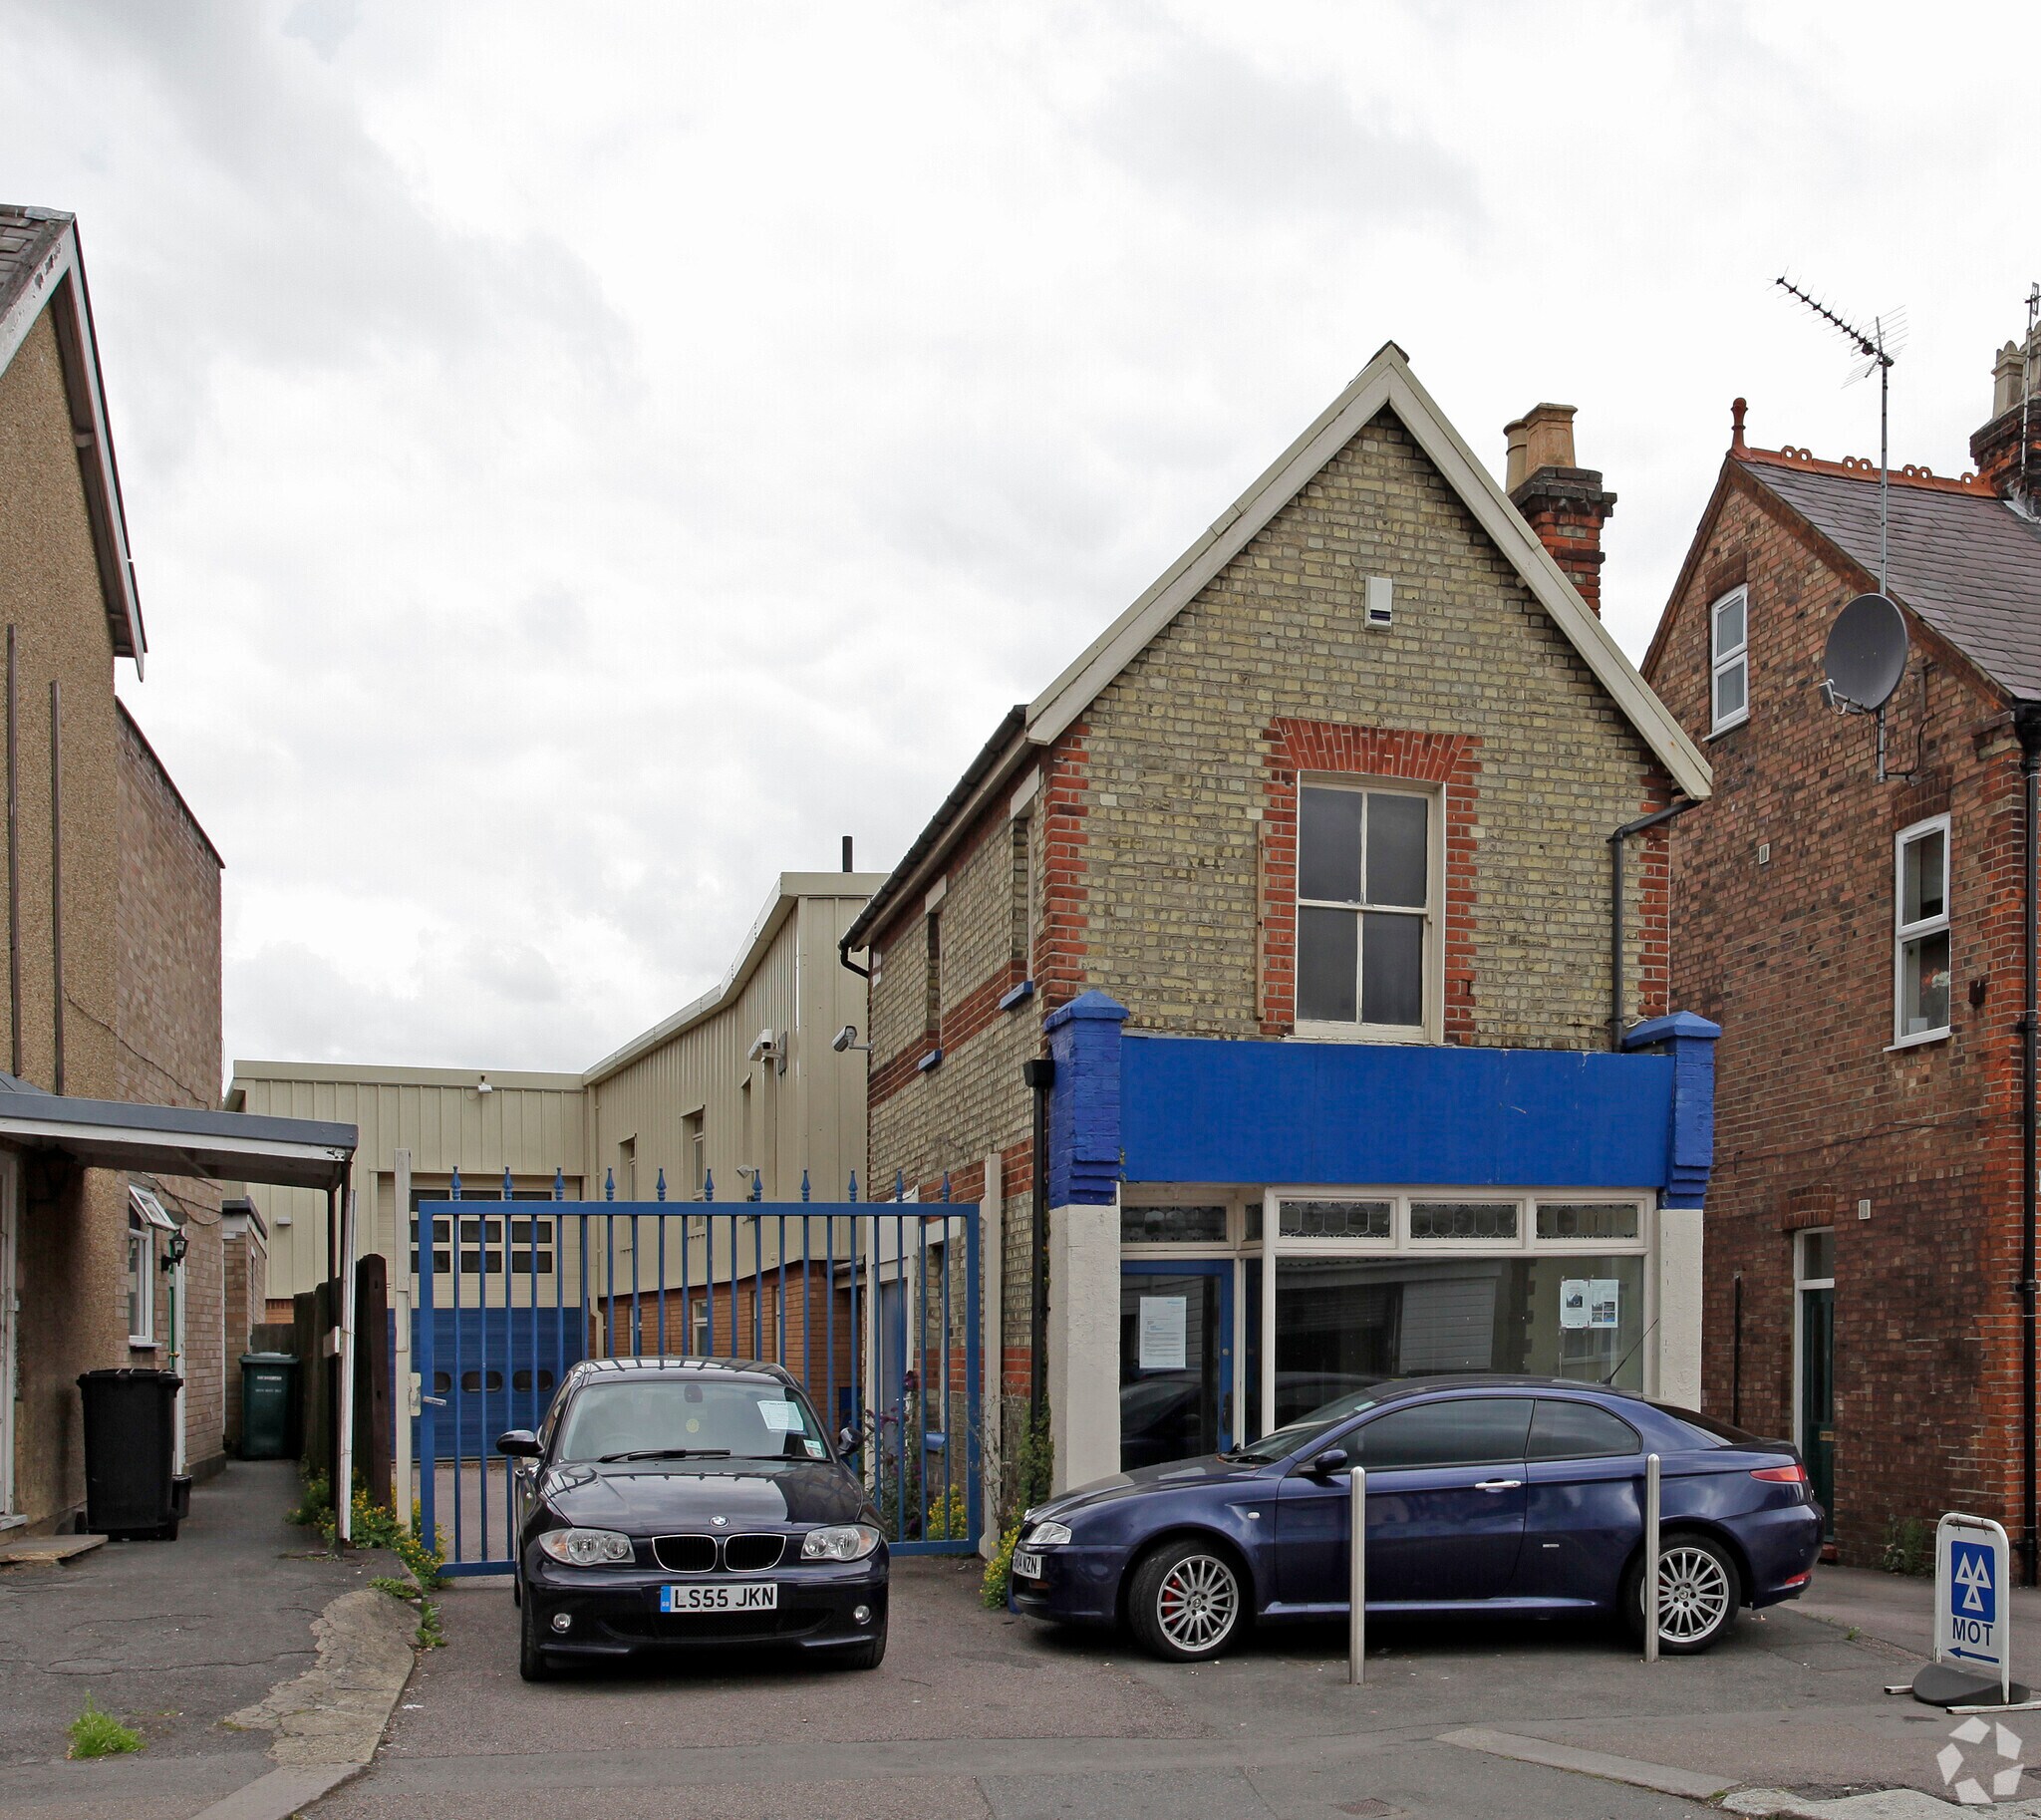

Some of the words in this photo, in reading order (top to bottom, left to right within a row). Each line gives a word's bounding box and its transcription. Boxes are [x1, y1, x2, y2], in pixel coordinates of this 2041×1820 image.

[674, 1588, 729, 1609] LS55
[735, 1587, 774, 1607] JKN
[1952, 1617, 1994, 1647] MOT
